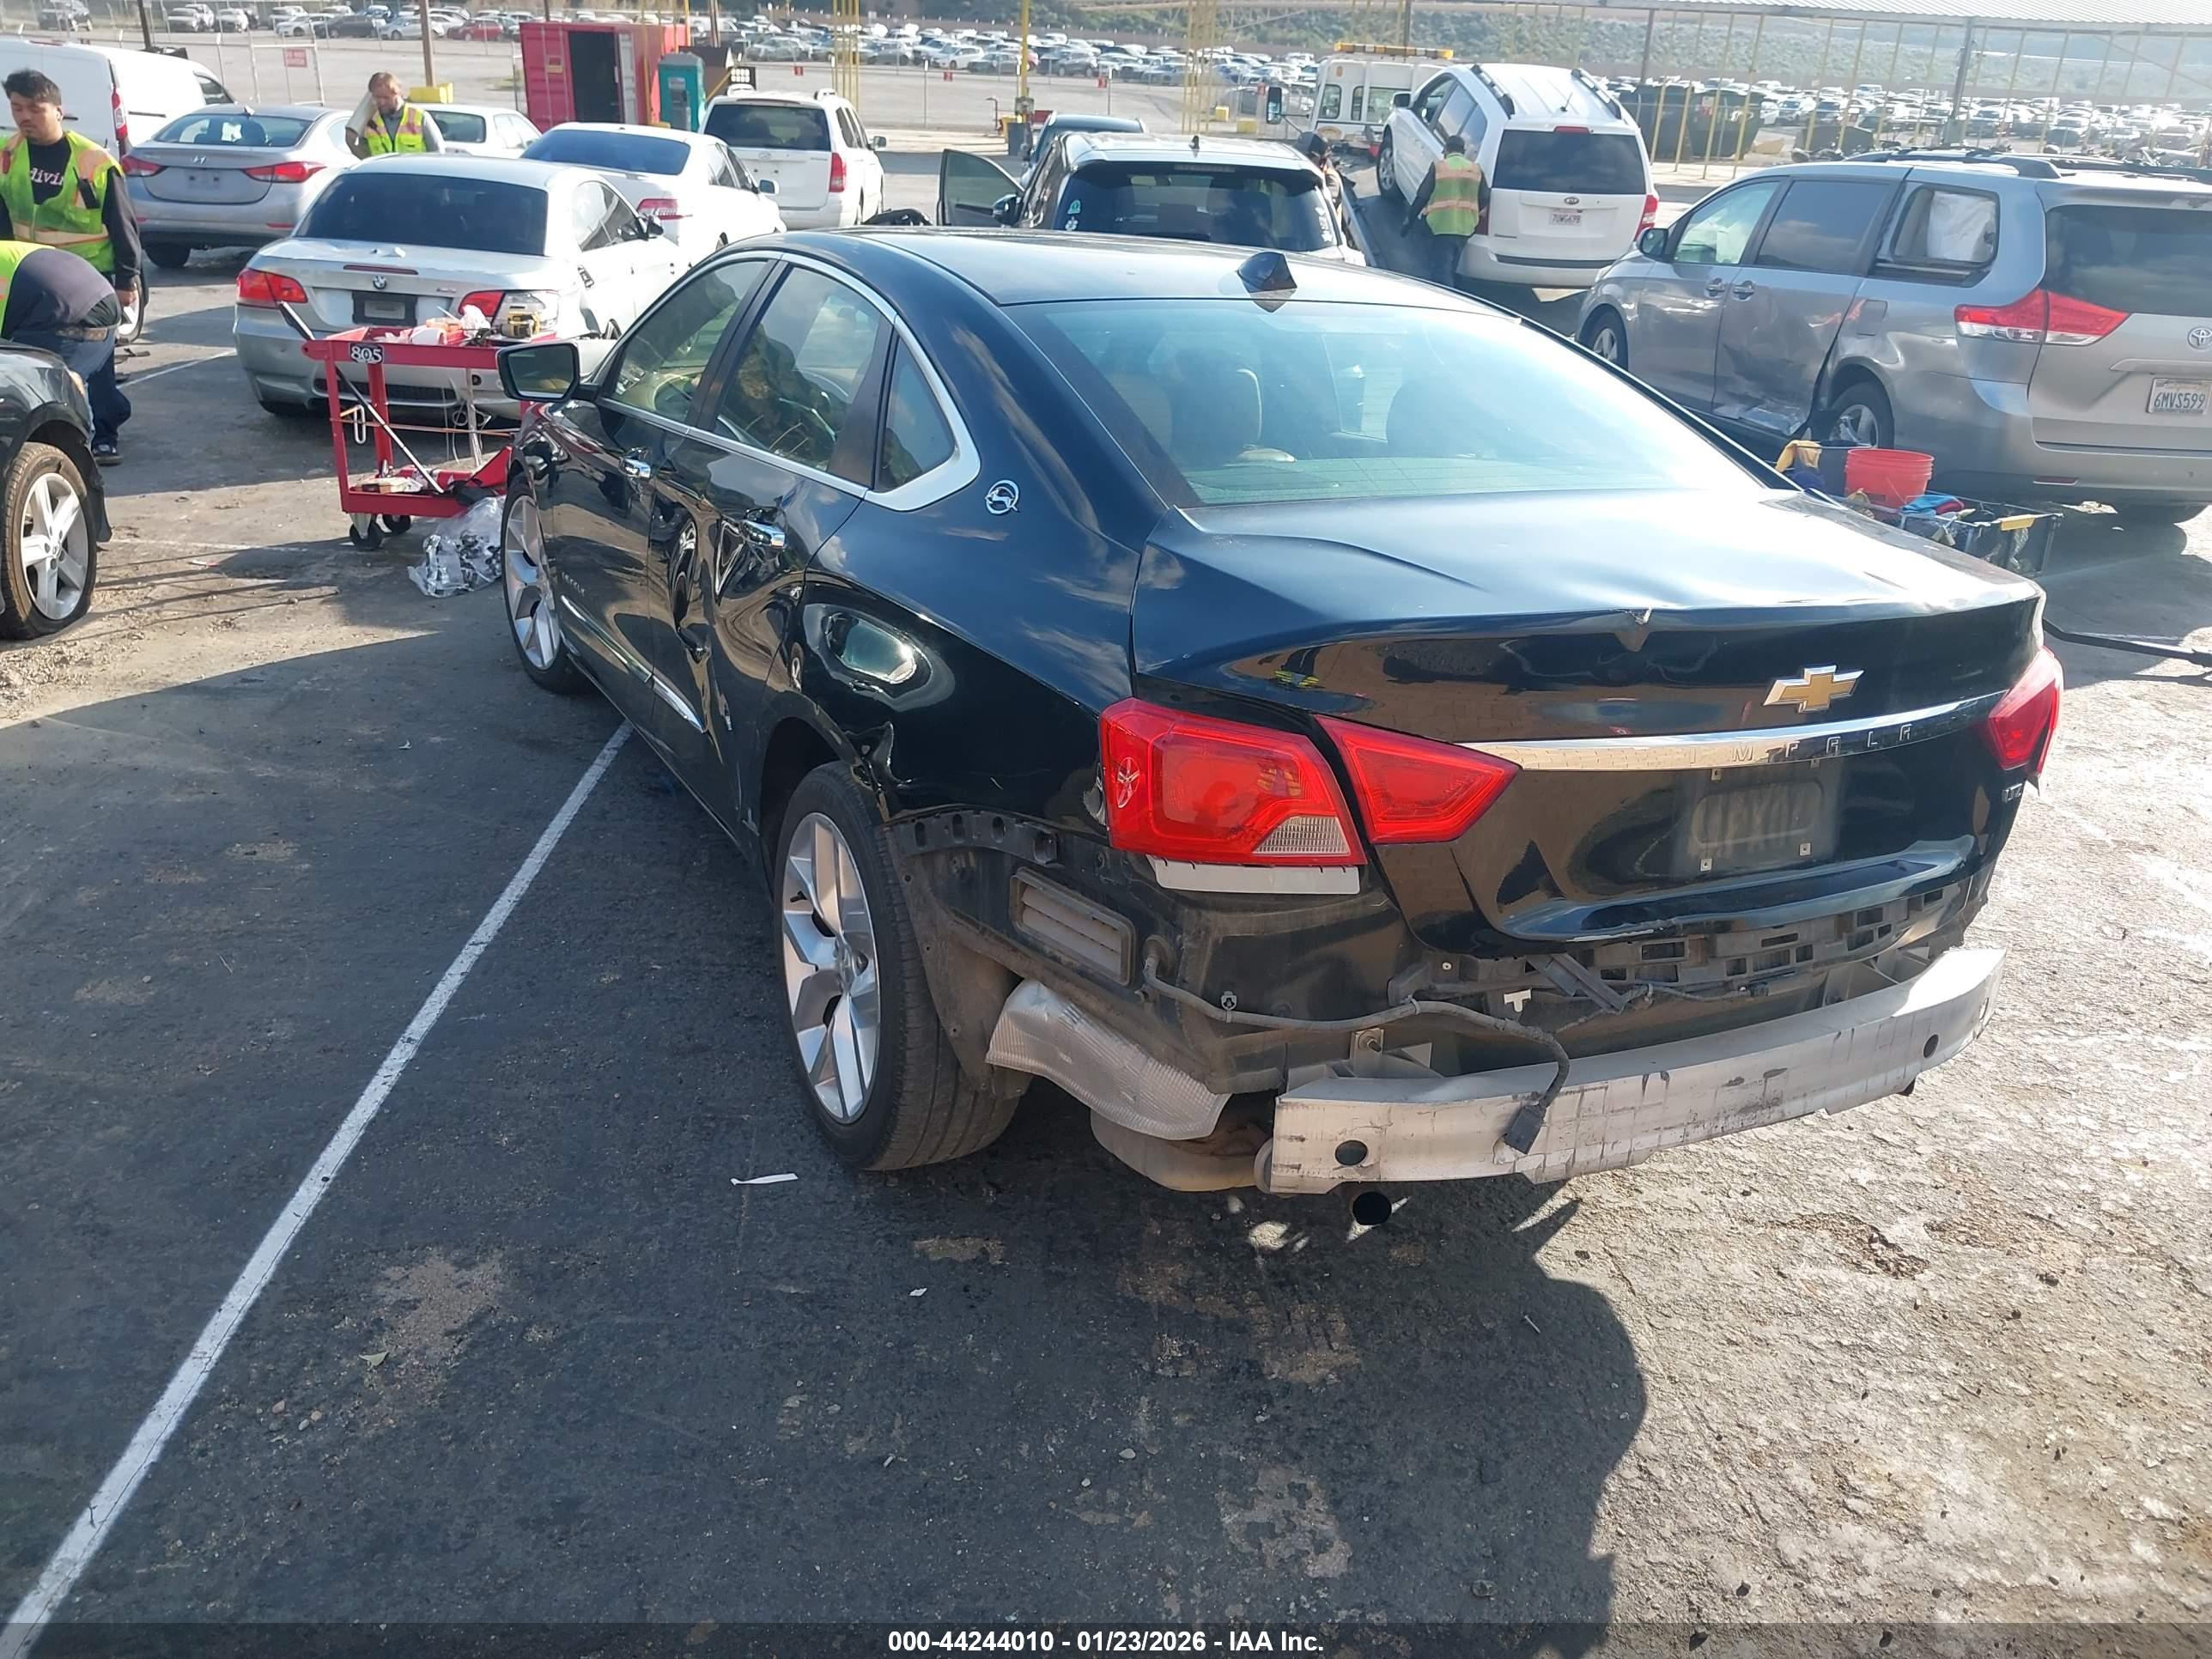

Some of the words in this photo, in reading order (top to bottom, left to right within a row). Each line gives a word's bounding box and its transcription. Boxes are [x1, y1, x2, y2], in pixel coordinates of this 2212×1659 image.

[350, 345, 382, 364] 805
[2154, 392, 2206, 409] 6MVS599
[1688, 723, 1913, 765] IMPALA
